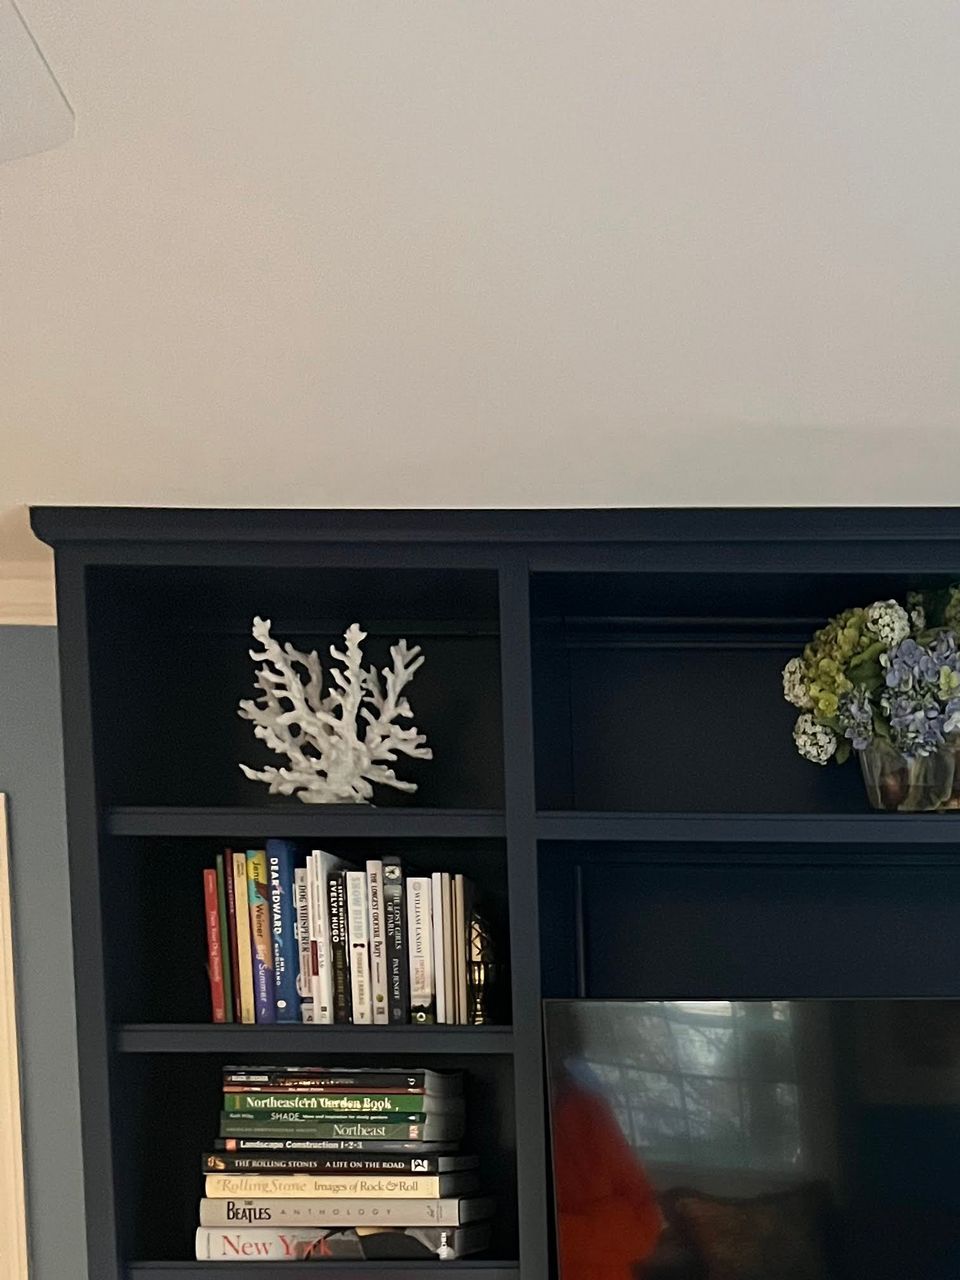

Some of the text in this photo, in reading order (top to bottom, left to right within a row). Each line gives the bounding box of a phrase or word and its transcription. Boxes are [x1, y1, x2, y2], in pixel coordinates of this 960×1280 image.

[270, 858, 282, 934] DEAR EDWARD
[299, 885, 307, 902] DOG
[371, 886, 379, 910] LONGEST
[255, 904, 264, 938] Weiner
[330, 881, 339, 942] EVELYN HUGO
[259, 964, 268, 1002] Summer
[246, 1096, 317, 1108] Northeastern
[363, 1097, 391, 1109] Book
[271, 1112, 300, 1120] SHADE
[333, 1124, 386, 1136] Northeast
[240, 1141, 363, 1150] Landscape Construction 1-2-3
[216, 1178, 418, 1194] Rolling Stone Images of Rock & Roll
[227, 1201, 272, 1223] BEATLES
[222, 1235, 272, 1256] New
